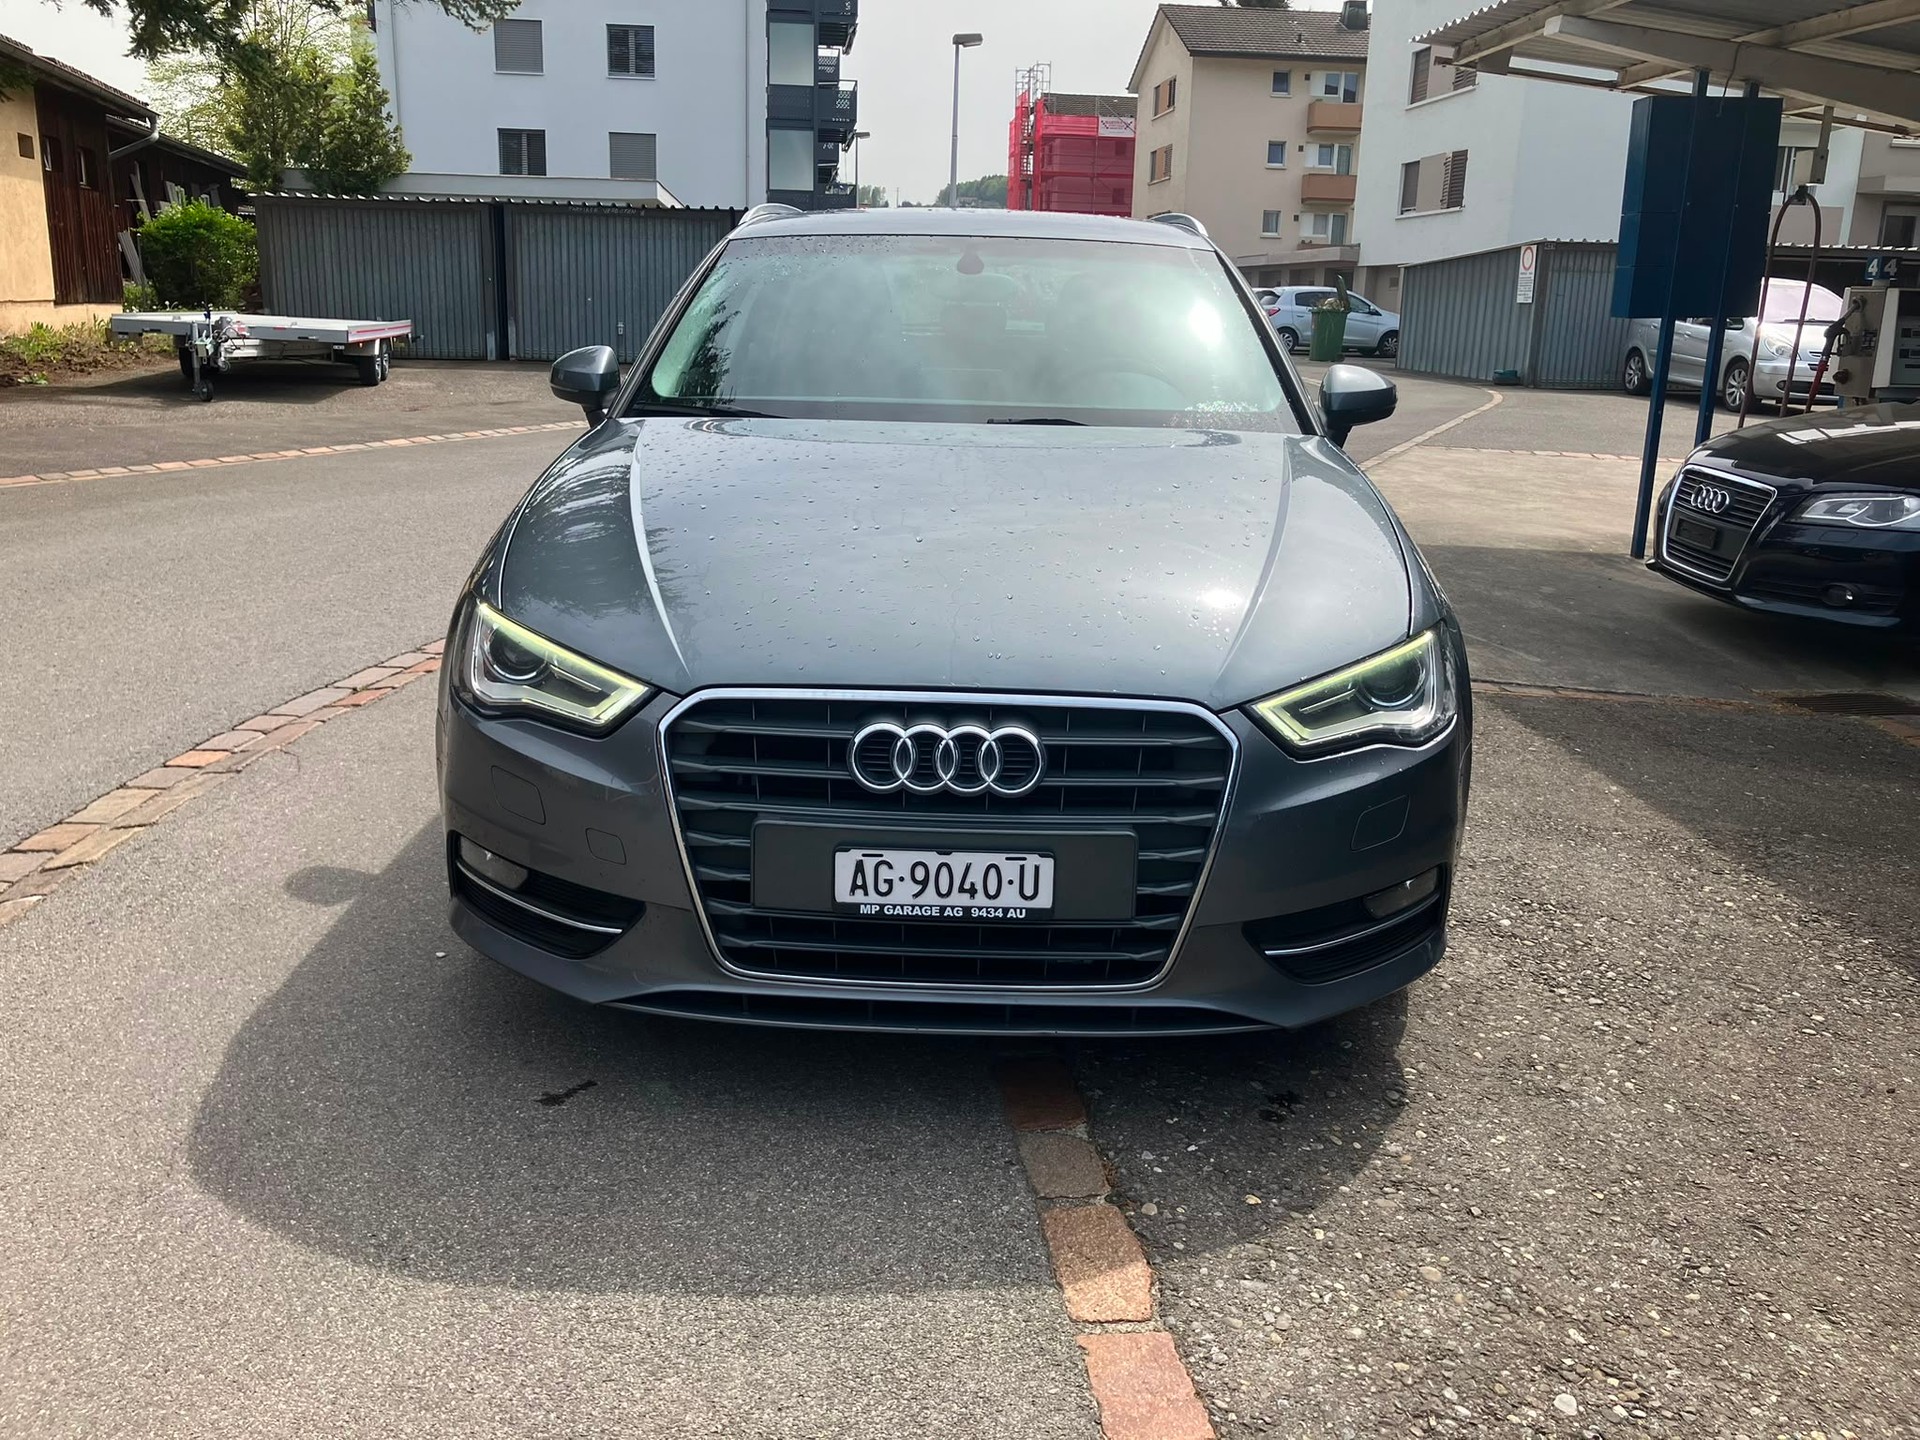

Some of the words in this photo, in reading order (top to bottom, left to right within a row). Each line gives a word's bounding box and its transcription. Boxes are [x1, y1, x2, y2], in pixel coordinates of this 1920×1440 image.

[1868, 259, 1878, 276] 4
[1884, 259, 1897, 276] 4
[859, 904, 880, 914] MP
[883, 904, 940, 917] GARAGE
[943, 906, 963, 917] AG
[970, 907, 1003, 918] 9434
[1006, 908, 1026, 919] AU
